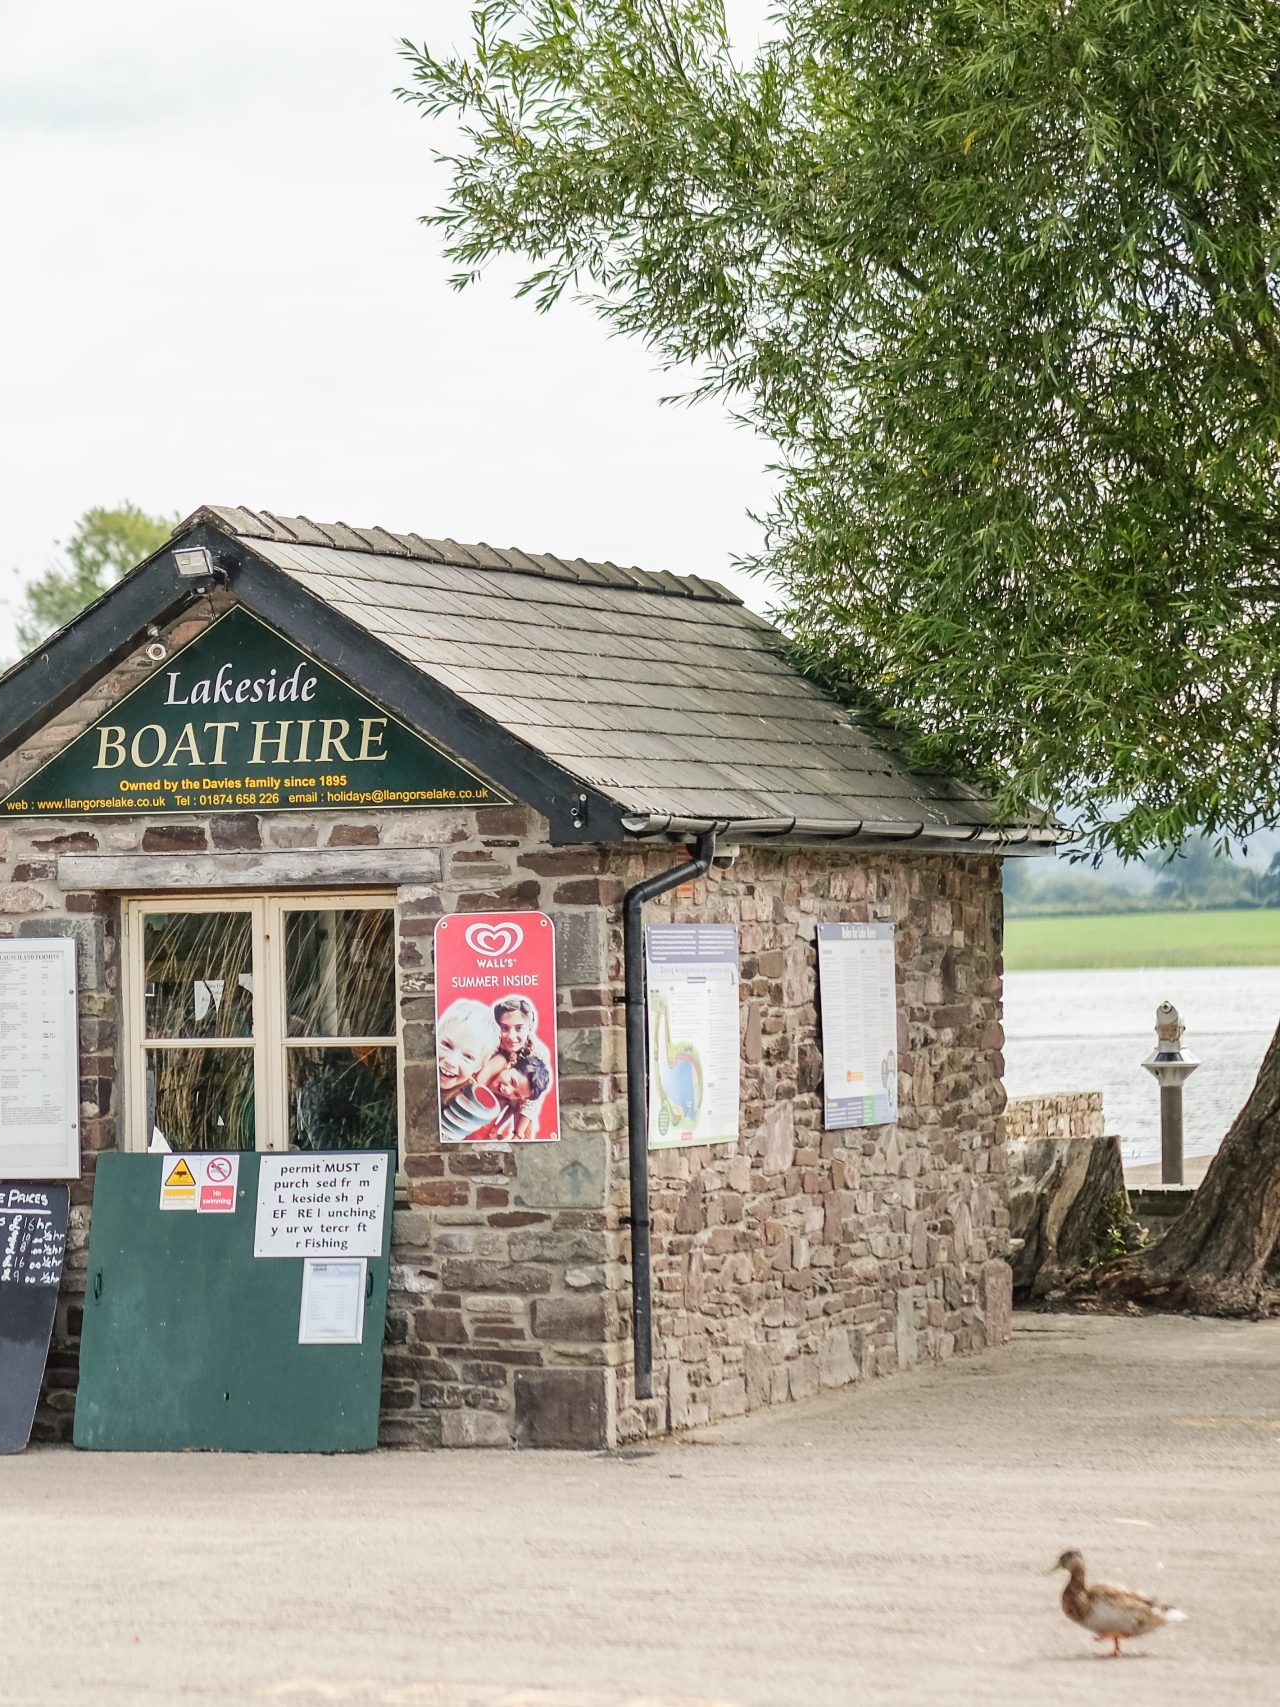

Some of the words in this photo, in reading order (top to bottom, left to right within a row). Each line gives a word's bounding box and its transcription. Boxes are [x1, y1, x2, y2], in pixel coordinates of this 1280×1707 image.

[164, 662, 318, 707] Lakeside
[93, 721, 239, 769] BOAT
[247, 717, 388, 766] HIRE
[119, 780, 161, 792] Owned
[164, 779, 178, 793] by
[181, 779, 200, 790] the
[202, 778, 241, 790] Davies
[244, 776, 280, 790] family
[284, 776, 316, 787] since
[319, 775, 347, 787] 1895
[6, 801, 28, 811] web
[37, 796, 166, 811] www.llangorselake.co.uk
[174, 795, 190, 806] Tel
[199, 794, 232, 806] 01874
[235, 794, 256, 805] 658
[258, 793, 279, 805] 226
[288, 792, 318, 803] email
[327, 788, 488, 803] holidays@llangorselake.co.uk
[476, 958, 514, 969] WALL'S
[451, 975, 499, 988] SUMMER
[503, 974, 539, 987] INSIDE
[280, 1163, 321, 1176] permit
[324, 1162, 360, 1173] MUST
[7, 1189, 48, 1207] PRICES
[305, 1238, 348, 1250] Fishing
